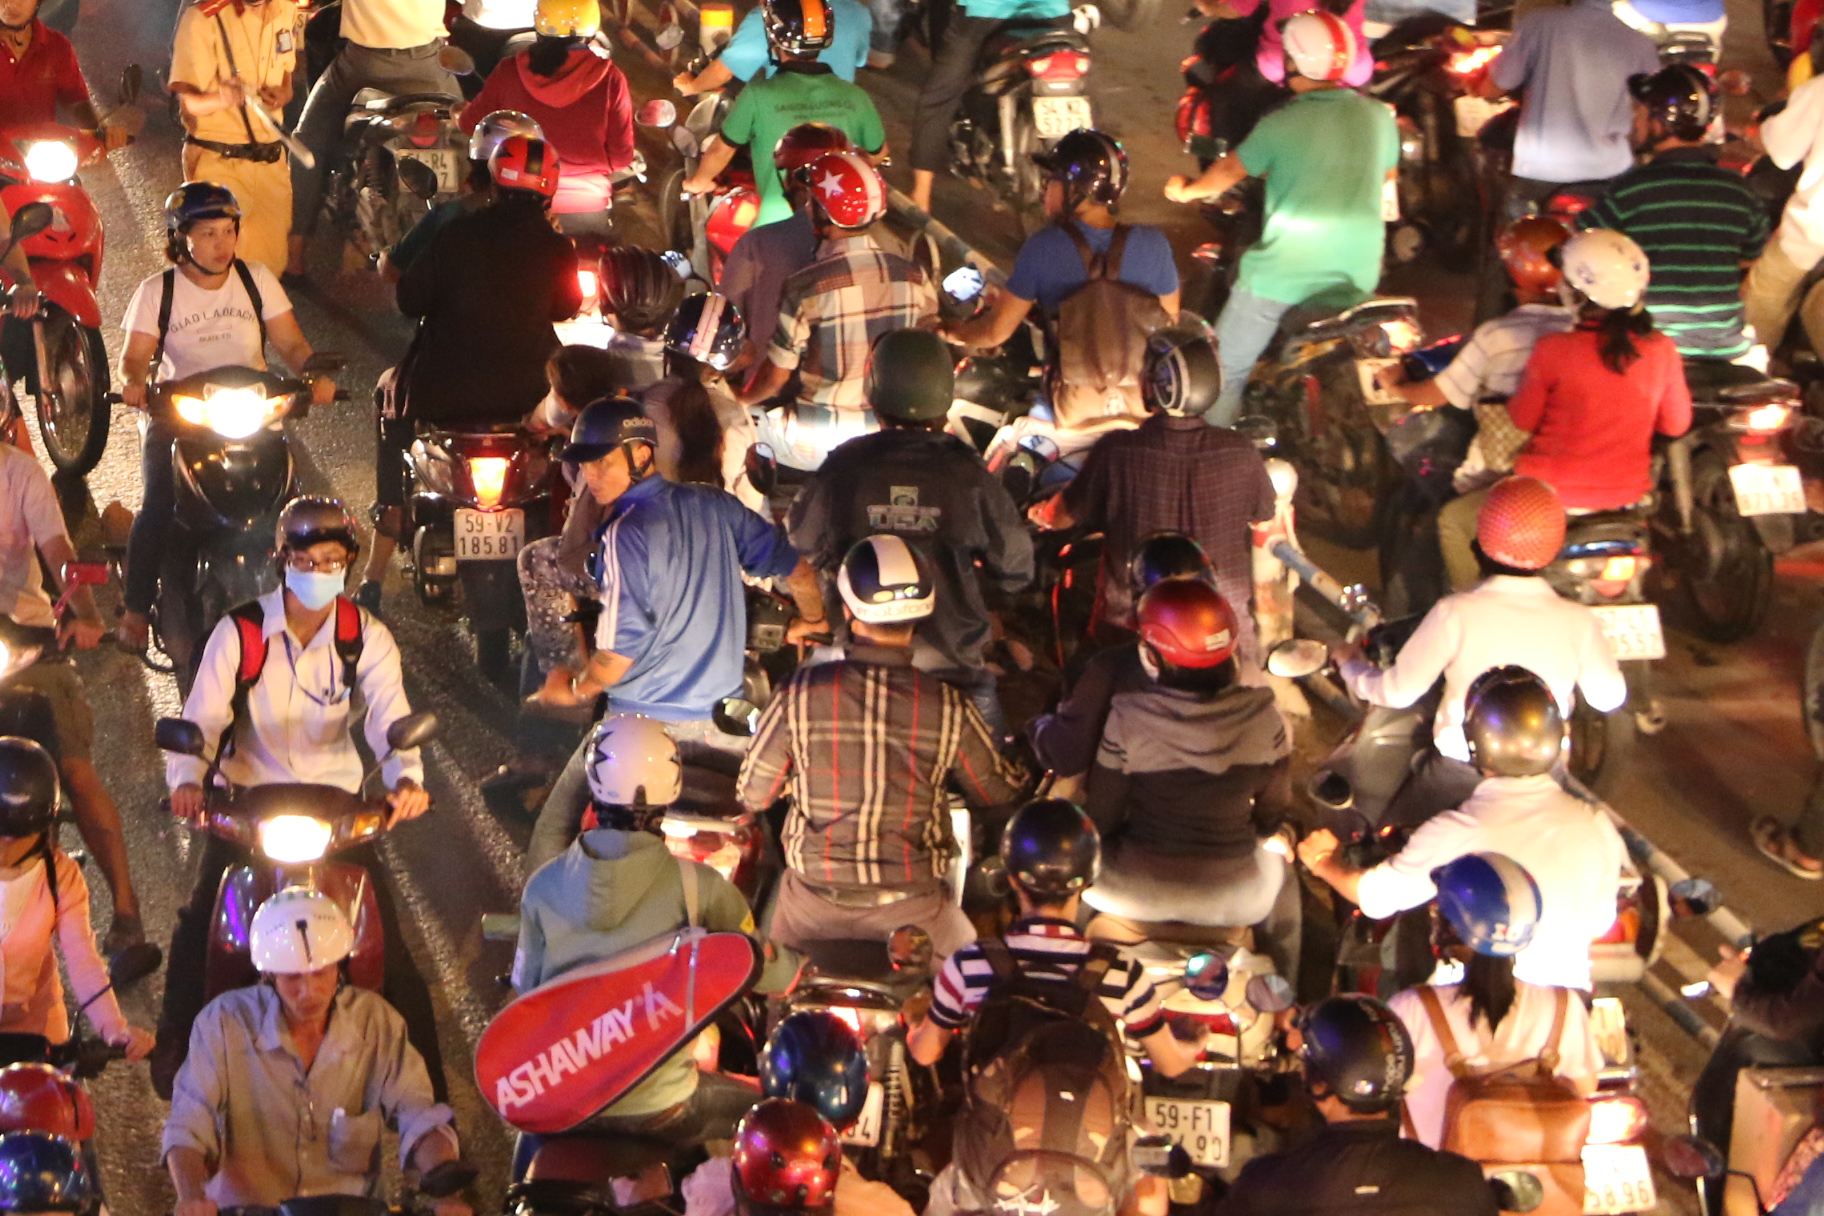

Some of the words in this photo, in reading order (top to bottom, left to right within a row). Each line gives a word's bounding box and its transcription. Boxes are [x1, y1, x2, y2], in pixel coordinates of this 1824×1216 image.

[464, 514, 514, 534] 59-V2
[459, 535, 520, 556] 185.81
[495, 999, 634, 1116] ASHAWAY
[1155, 1103, 1213, 1133] 59-F1
